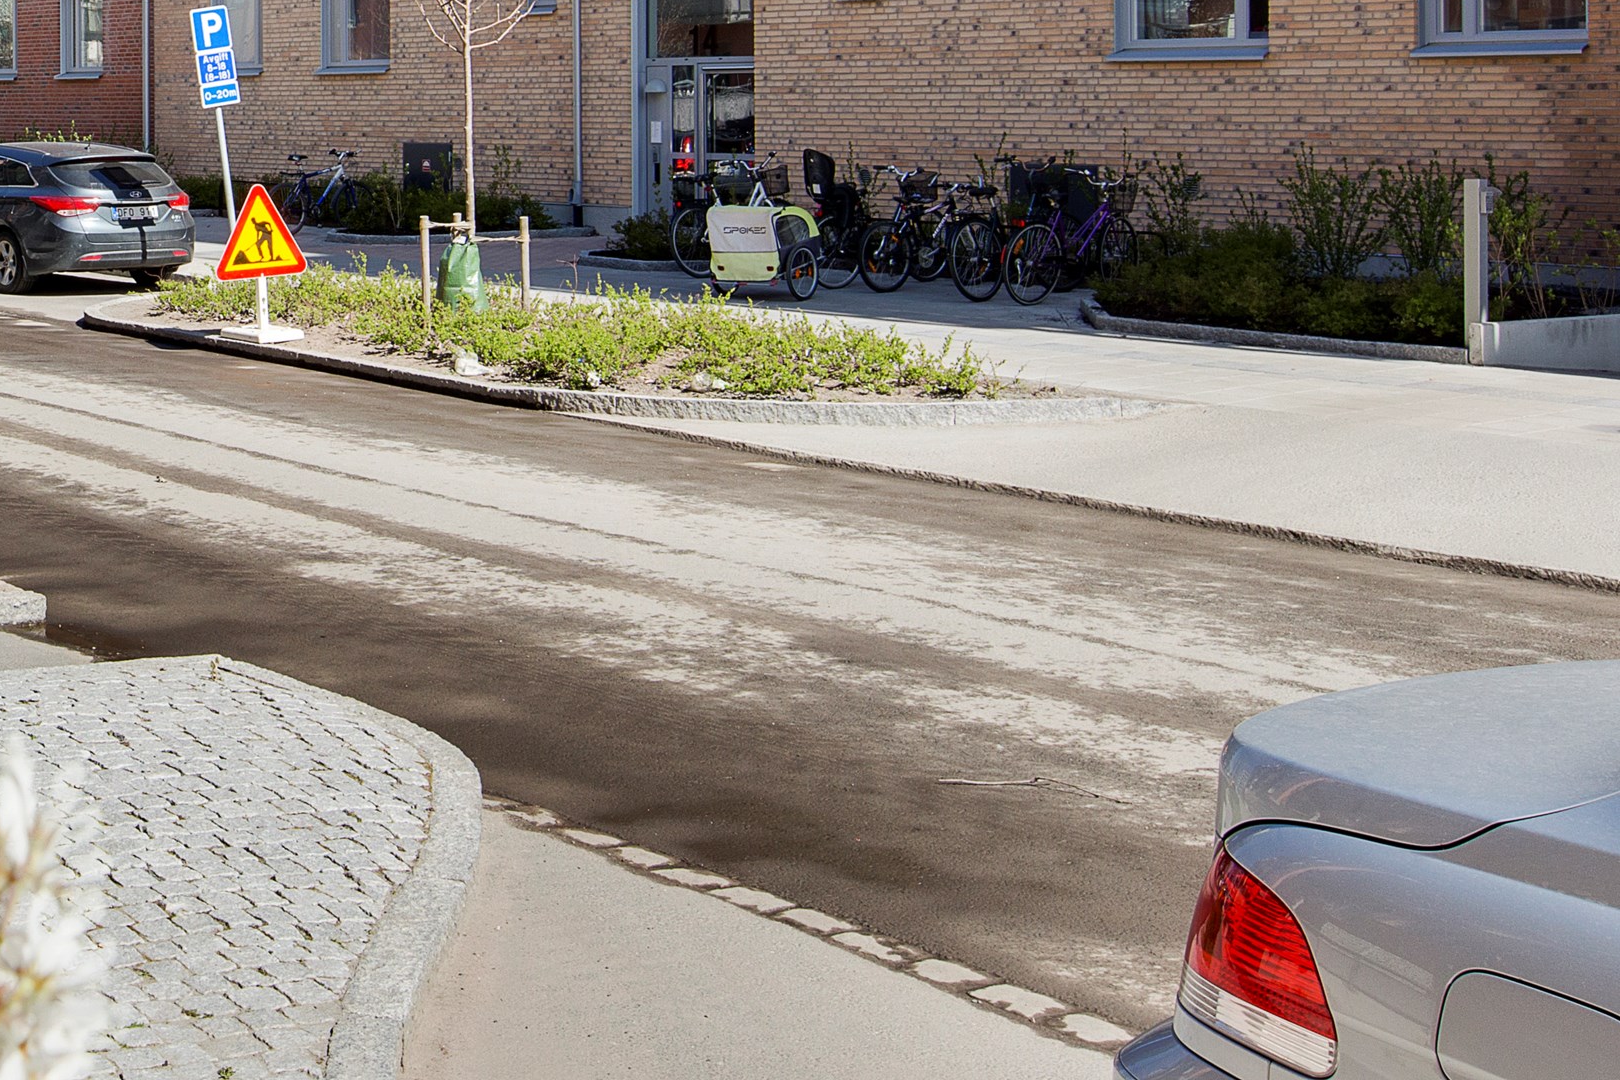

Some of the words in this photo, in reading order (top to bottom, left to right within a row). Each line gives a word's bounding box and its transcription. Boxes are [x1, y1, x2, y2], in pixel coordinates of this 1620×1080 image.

[200, 12, 222, 47] P
[689, 25, 719, 57] 14
[203, 52, 229, 65] Avgift
[207, 61, 227, 72] 8-18
[205, 69, 231, 83] (8-18)
[723, 226, 767, 235] SPOKES
